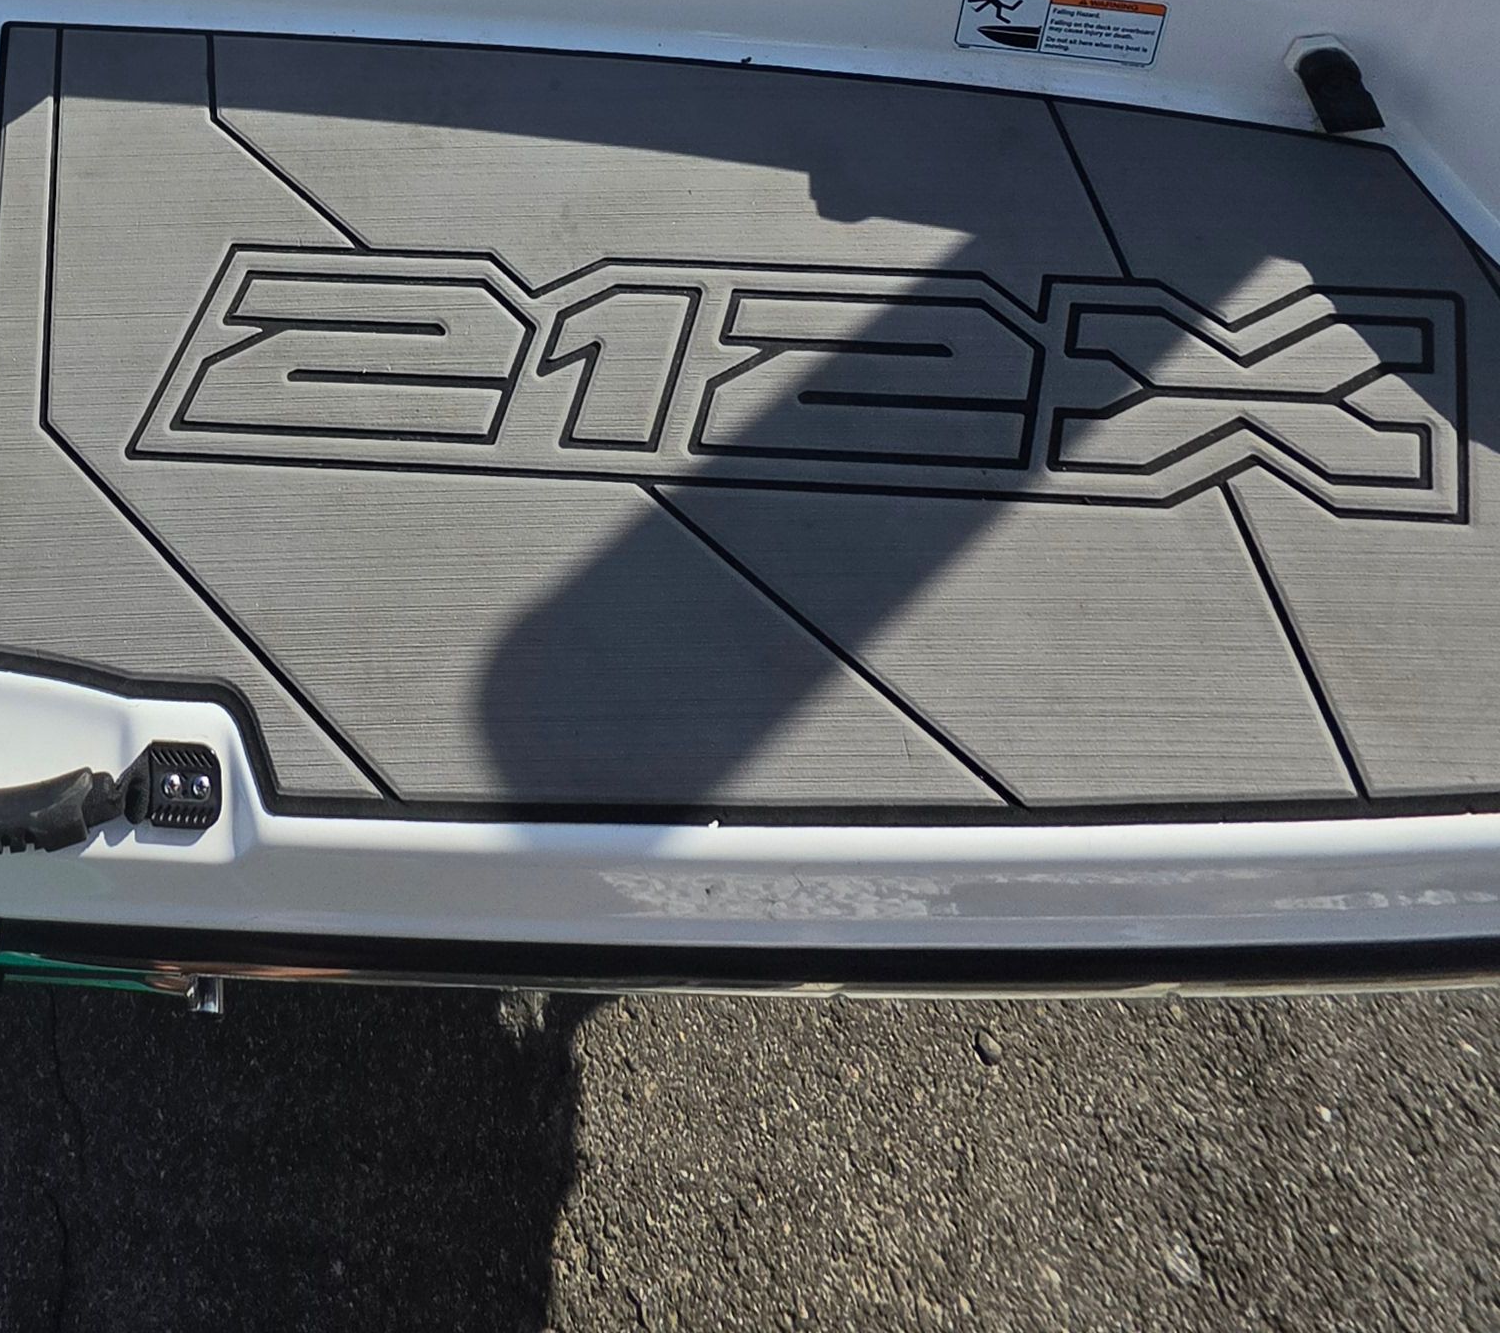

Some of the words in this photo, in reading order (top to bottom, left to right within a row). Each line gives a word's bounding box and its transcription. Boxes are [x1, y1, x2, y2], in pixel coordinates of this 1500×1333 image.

[1090, 0, 1139, 11] WARNING
[1053, 8, 1075, 17] Falling
[1050, 18, 1072, 27] Falling
[169, 270, 1436, 489] 212X
